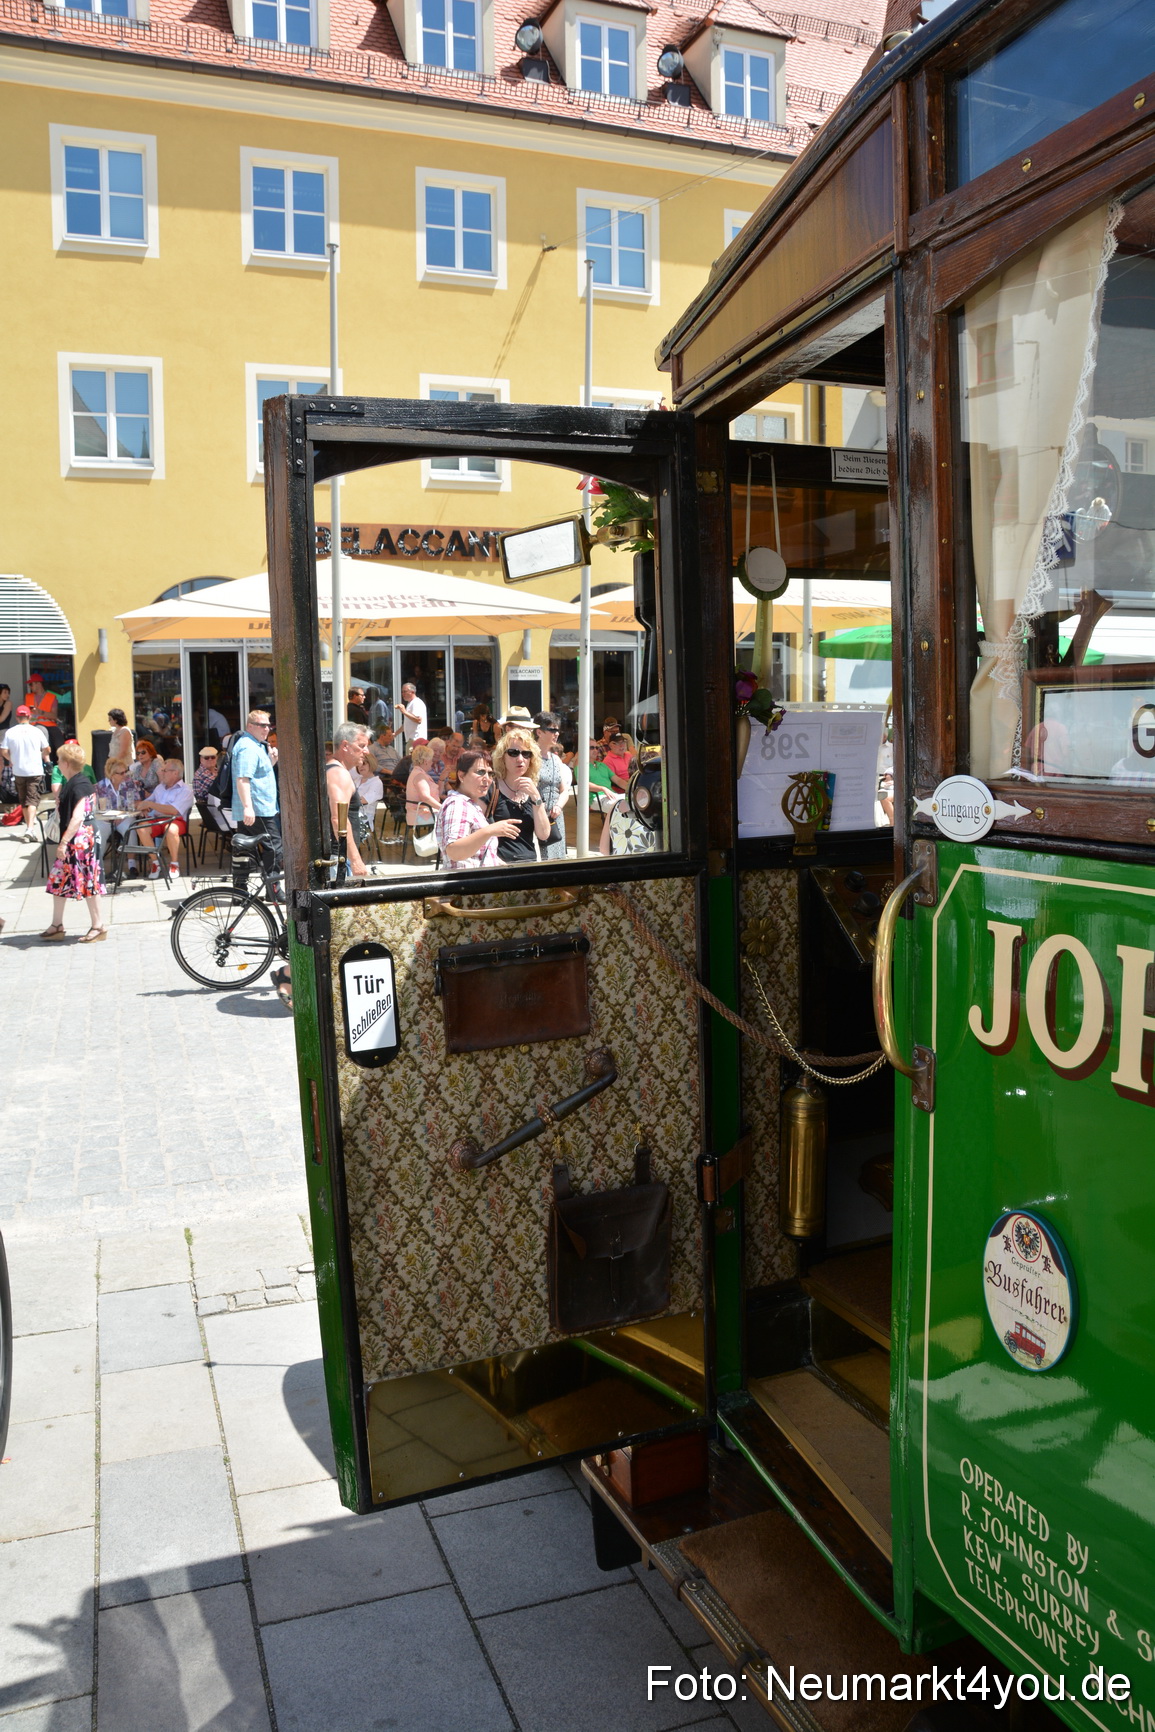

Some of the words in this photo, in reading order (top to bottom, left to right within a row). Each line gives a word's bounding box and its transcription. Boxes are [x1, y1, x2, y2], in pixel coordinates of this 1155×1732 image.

[838, 465, 863, 474] bediene
[865, 466, 881, 476] Dich
[843, 454, 861, 462] Beim
[315, 526, 504, 557] BELACCANT
[1132, 703, 1155, 758] G
[941, 798, 980, 824] Eingang
[353, 974, 385, 995] Tür
[351, 993, 392, 1040] schließen
[1011, 1256, 1041, 1280] Geprüfter
[986, 1260, 1066, 1325] Busfahrer
[959, 1457, 1050, 1542] OPERATED
[963, 1524, 1008, 1584] KEW,
[1021, 1572, 1100, 1656] SURREY
[1106, 1608, 1126, 1641] &
[1136, 1628, 1155, 1663] S
